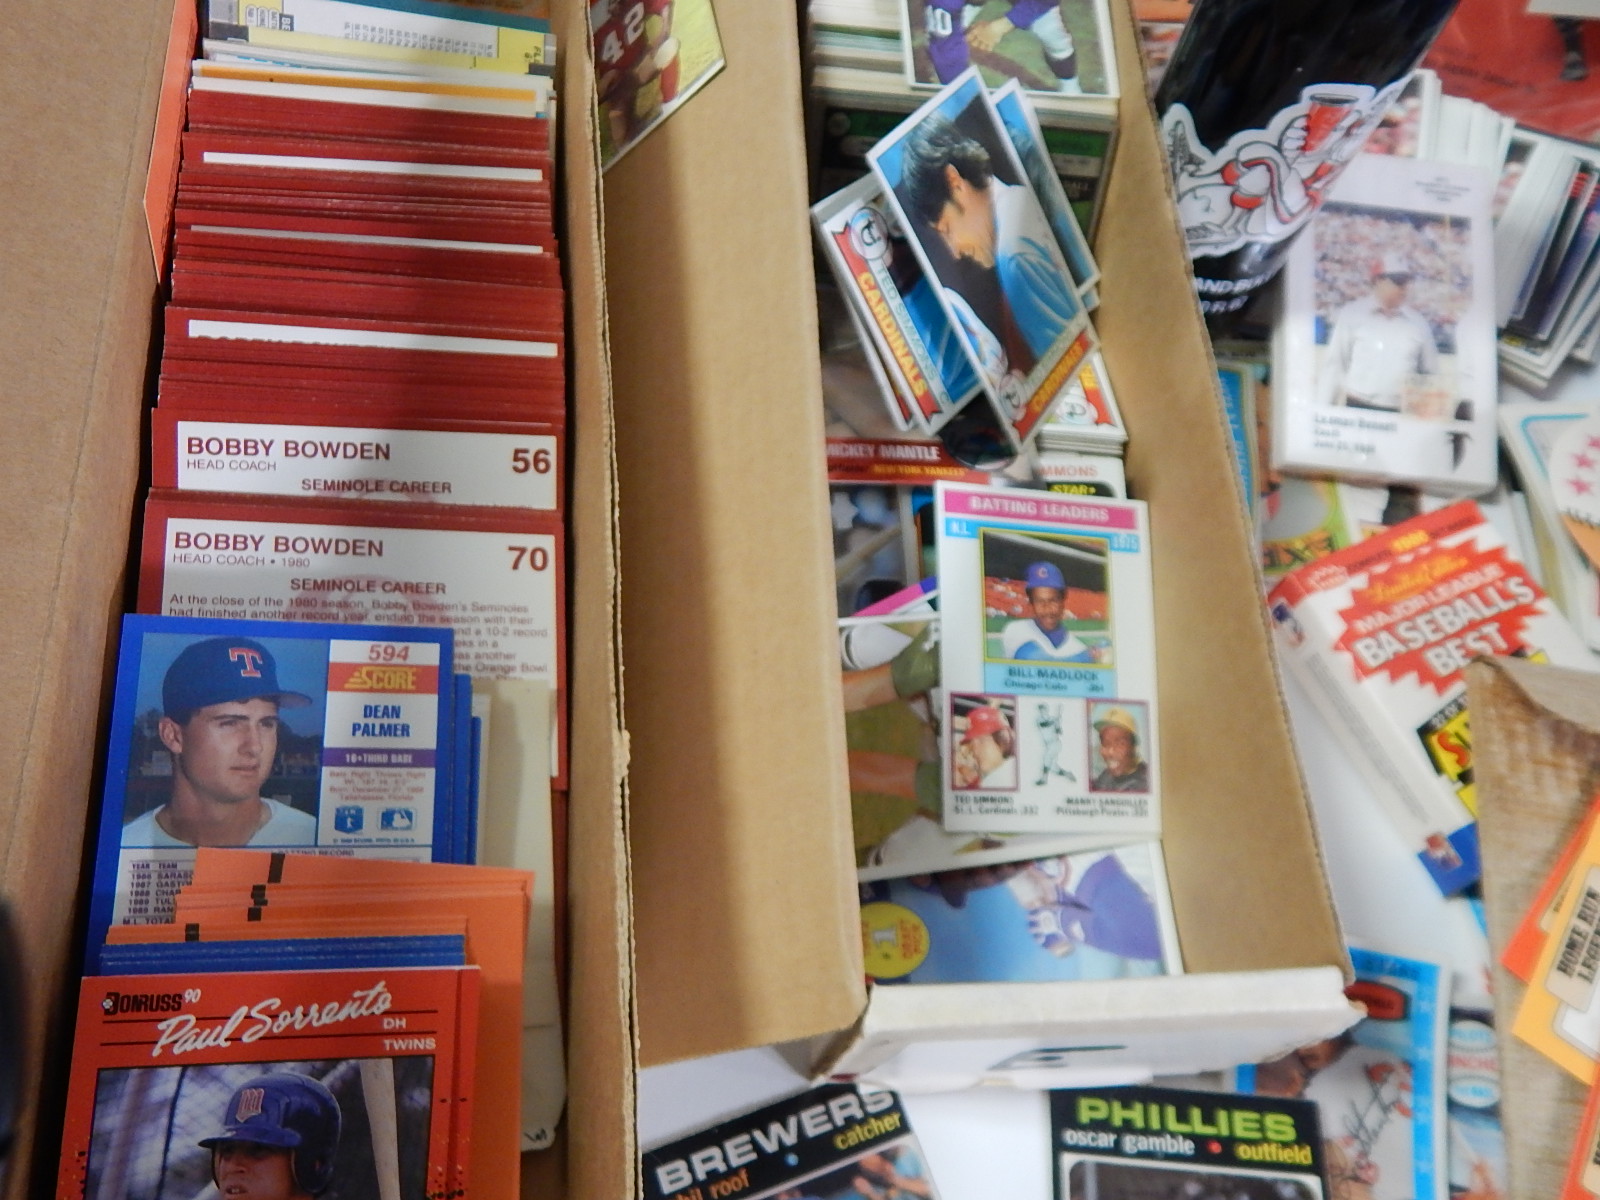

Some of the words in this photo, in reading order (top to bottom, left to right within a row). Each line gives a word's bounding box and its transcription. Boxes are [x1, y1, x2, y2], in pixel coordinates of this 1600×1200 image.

[602, 2, 645, 64] 42
[857, 271, 930, 399] CARDINALS
[187, 436, 274, 457] BOBBY
[283, 439, 391, 460] BOWDEN
[880, 445, 942, 460] MANTLE
[186, 458, 225, 471] HEAD
[228, 460, 277, 472] COACH
[512, 448, 551, 475] 56
[301, 478, 385, 494] SEMINOLE
[389, 480, 452, 495] CAREER
[971, 496, 1037, 516] BATTING
[1043, 503, 1109, 522] LEADERS
[174, 531, 265, 553] BOBBY
[273, 535, 384, 557] BOWDEN
[173, 553, 212, 565] HEAD
[215, 554, 265, 567] COACH
[280, 556, 311, 568] 1980
[508, 545, 549, 572] 70
[290, 578, 376, 593] SEMINOLE
[381, 580, 447, 595] CAREER
[1355, 592, 1422, 632] MAJOR
[1425, 565, 1505, 604] LEAGUE
[169, 593, 185, 605] At
[187, 594, 208, 606] the
[211, 595, 244, 607] close
[247, 596, 261, 607] of
[265, 597, 283, 608] the
[371, 600, 411, 613] Bobby
[413, 601, 467, 613] Bowden's
[470, 602, 529, 614] Seminoles
[197, 608, 248, 619] finished
[252, 609, 297, 620] another
[301, 610, 340, 621] record
[374, 612, 414, 625] ending
[417, 612, 436, 623] the
[439, 615, 478, 625] season
[481, 615, 506, 625] with
[509, 615, 534, 625] their
[1353, 576, 1536, 670] BASEBALL'S
[486, 628, 509, 638] 10-2
[513, 629, 548, 639] record
[368, 644, 411, 662] 594
[478, 651, 517, 660] another
[1424, 622, 1510, 678] BEST
[228, 647, 263, 678] T
[474, 663, 516, 675] Orange
[519, 662, 548, 673] Bowl
[1008, 666, 1034, 680] BILL
[1037, 668, 1099, 682] MADLOCK
[356, 666, 417, 690] SCORE
[362, 704, 402, 720] DEAN
[351, 722, 411, 738] PALMER
[1557, 924, 1589, 978] HOME
[152, 1013, 240, 1058] Paul
[242, 980, 393, 1043] Sorrento
[383, 1017, 407, 1029] DH
[384, 1037, 436, 1051] TWINS
[1076, 1096, 1297, 1143] PHILLIES
[656, 1088, 895, 1196] BREWERS
[1062, 1128, 1118, 1150] oscar
[1122, 1131, 1195, 1156] gamble
[1235, 1140, 1313, 1166] outfield
[709, 1172, 750, 1199] roof
[834, 1110, 902, 1152] catcher
